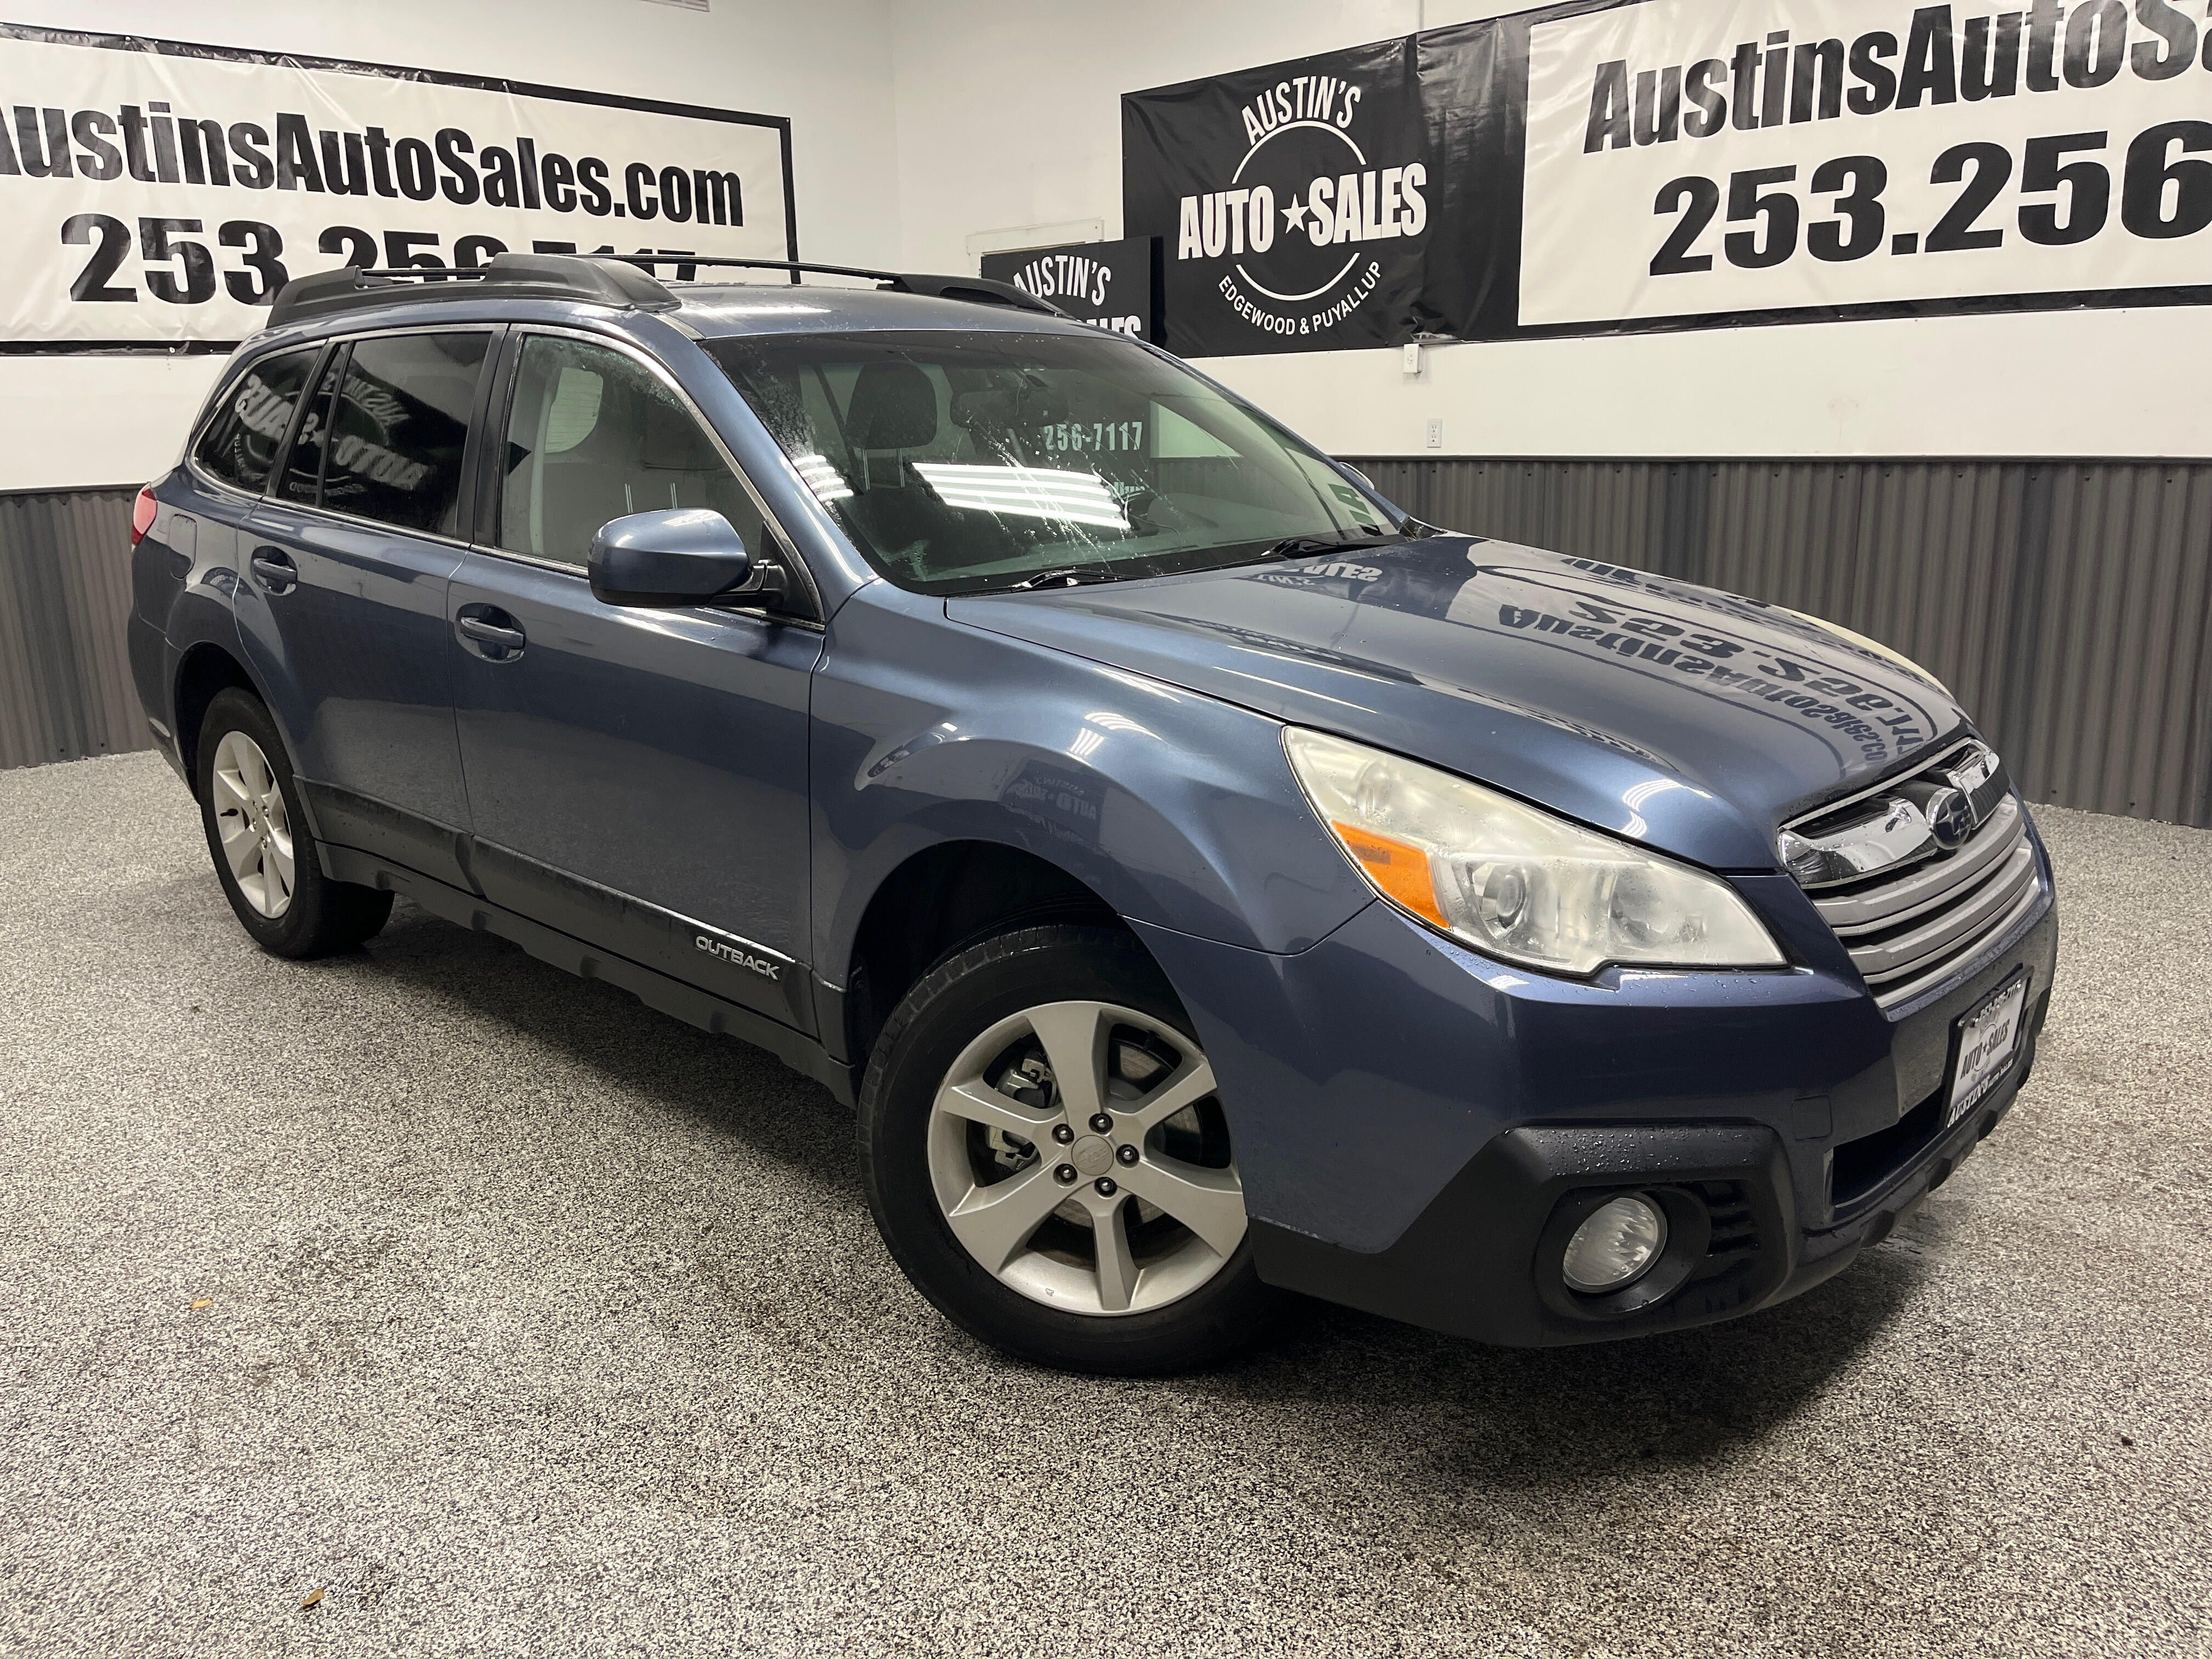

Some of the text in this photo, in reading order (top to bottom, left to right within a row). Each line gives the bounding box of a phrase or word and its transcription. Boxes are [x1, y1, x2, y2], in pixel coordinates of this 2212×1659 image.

[1242, 76, 1361, 146] AUSTIN'S
[1583, 0, 2212, 154] AustinsAutoS
[1178, 162, 1427, 260] AUTO SALES
[1649, 120, 2212, 276] 253.256
[1218, 261, 1381, 335] EDGEWOOD & PUYALLUP
[696, 935, 780, 981] OUTBACK
[1960, 1041, 1983, 1080] AUTO
[1987, 1019, 2010, 1056] SALES
